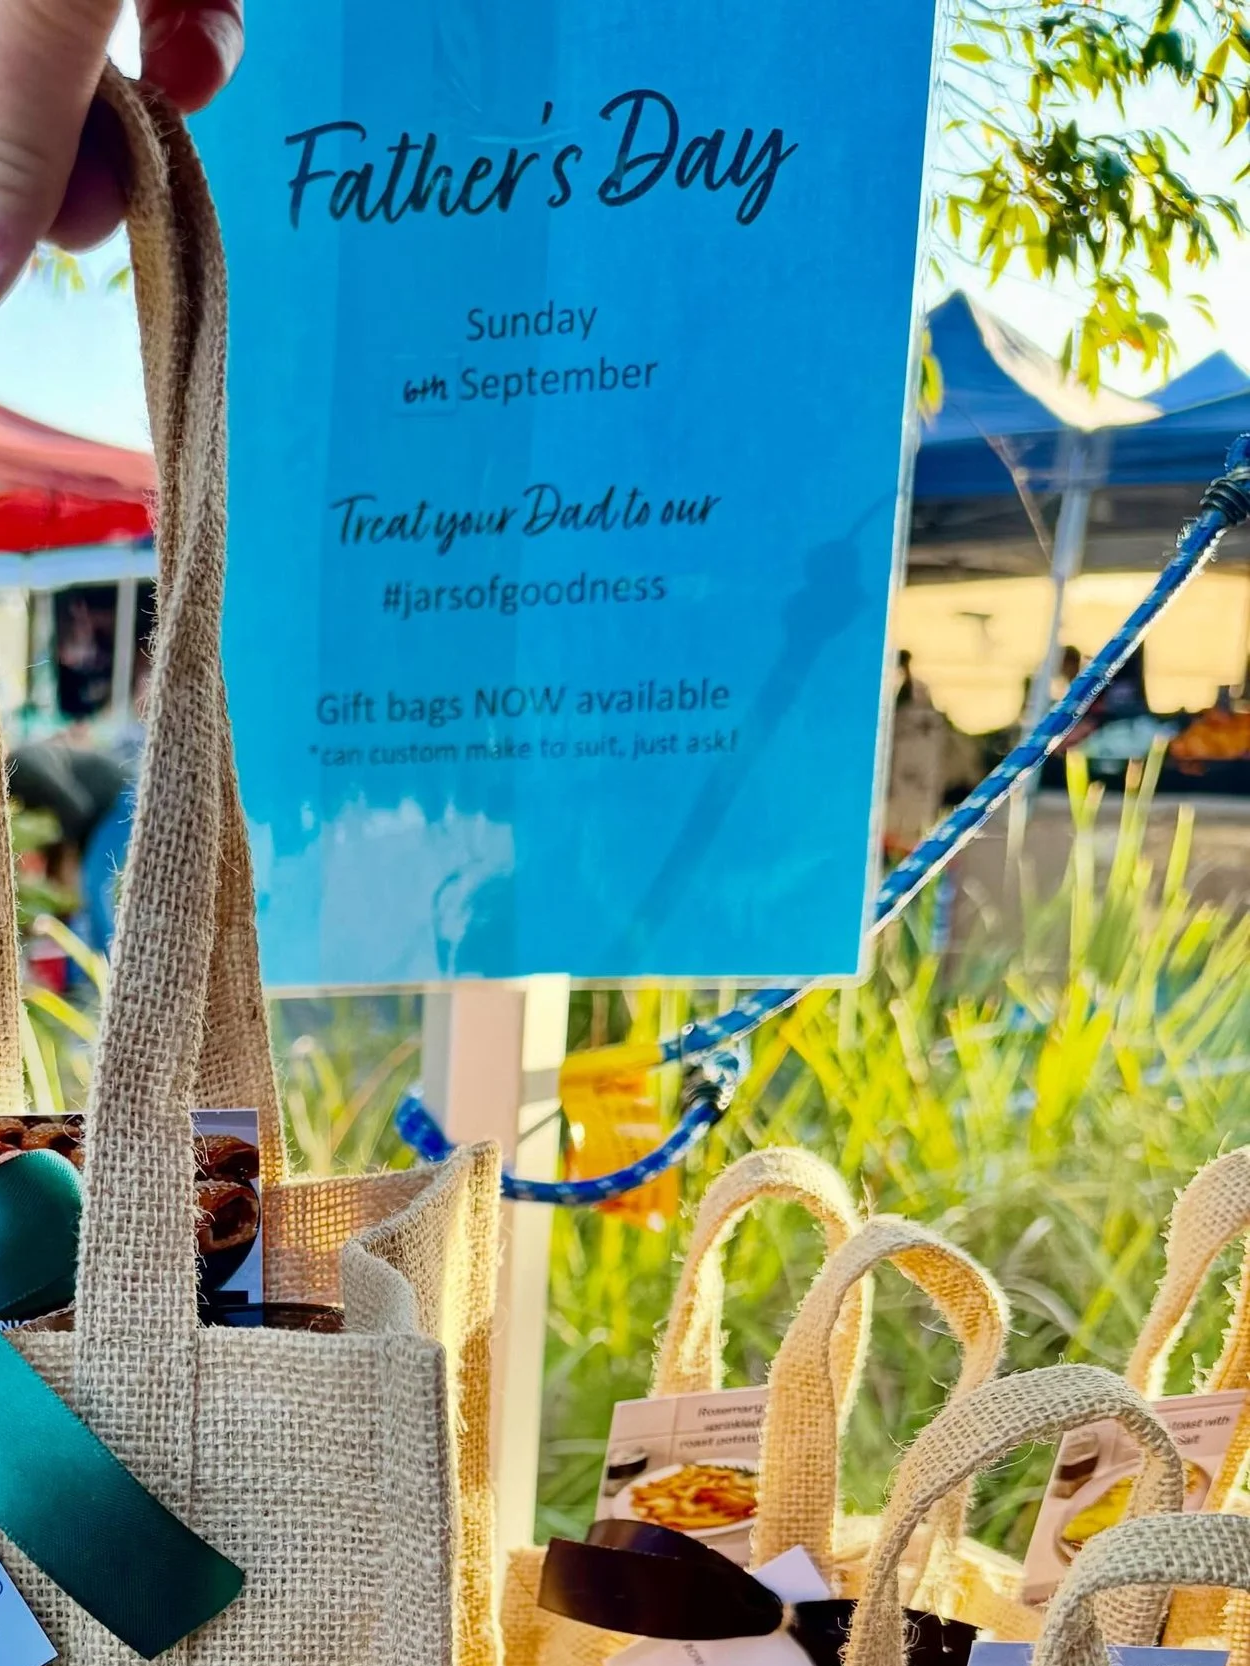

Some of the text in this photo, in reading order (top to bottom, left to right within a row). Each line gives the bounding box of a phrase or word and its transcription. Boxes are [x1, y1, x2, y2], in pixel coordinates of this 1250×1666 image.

[284, 89, 798, 229] Father's Day
[467, 301, 597, 341] Sunday
[403, 358, 657, 405] 6th September
[330, 484, 720, 555] Treat your Dad to our
[383, 571, 667, 620] #jarsofgoodness
[315, 678, 730, 727] Gift bags NOW available
[369, 742, 459, 765] custom
[466, 739, 531, 761] make
[540, 738, 565, 759] to
[632, 733, 679, 760] just
